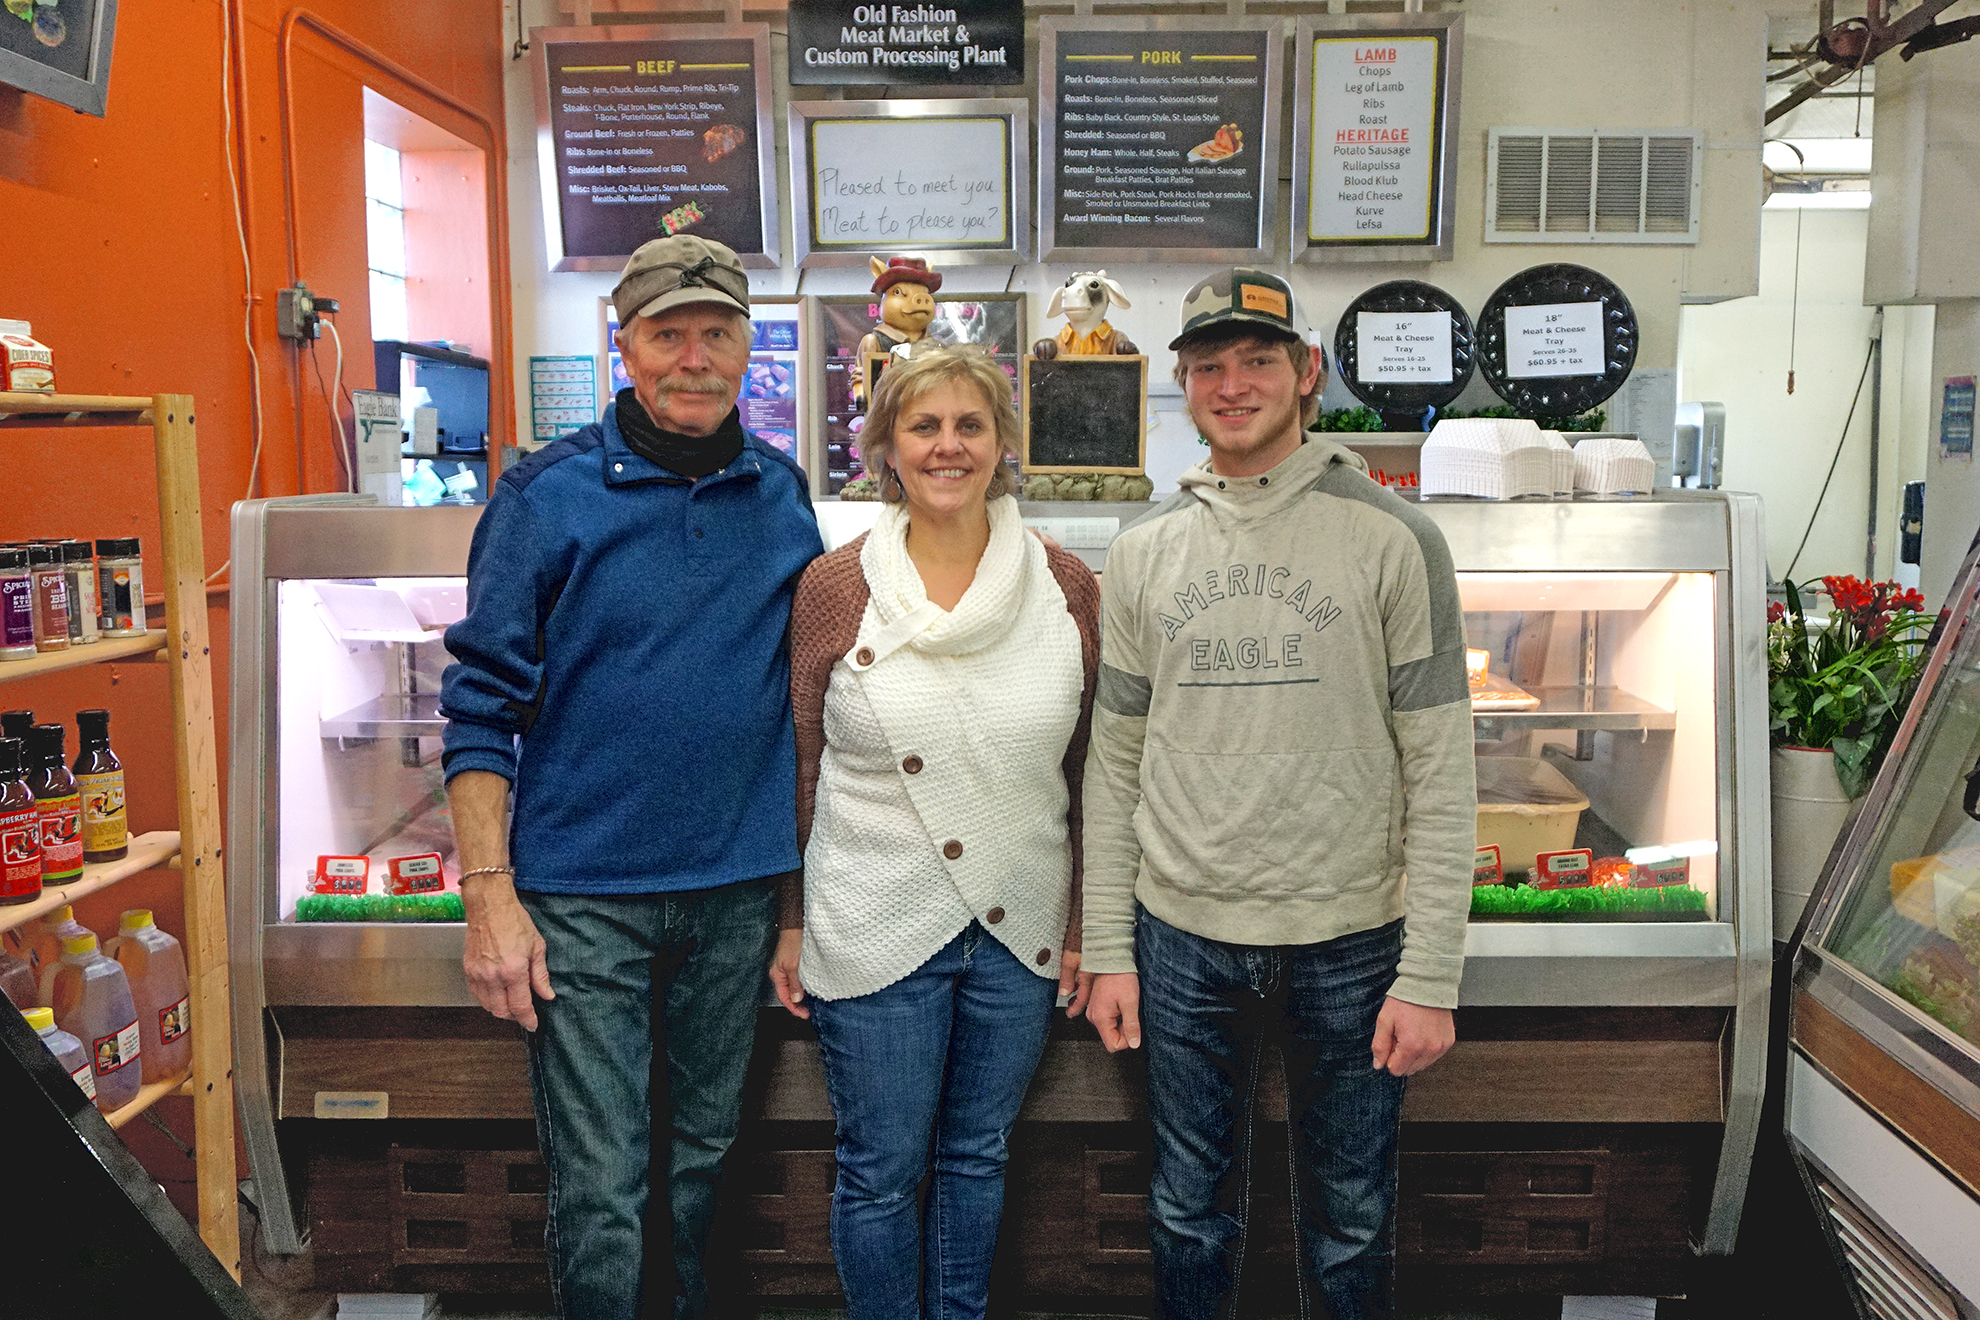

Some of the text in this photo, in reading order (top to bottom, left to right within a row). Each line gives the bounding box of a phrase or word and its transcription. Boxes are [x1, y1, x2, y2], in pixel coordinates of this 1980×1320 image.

[853, 4, 956, 23] Old Fashion
[841, 25, 969, 43] Meat Market &
[805, 45, 1006, 70] Custom Processing Plant
[1142, 51, 1181, 64] PORK
[1355, 49, 1397, 61] LAMB
[637, 60, 675, 73] BEEF
[1359, 66, 1391, 77] Chops
[1065, 76, 1083, 84] Pork
[1085, 76, 1111, 85] Chops:
[1140, 76, 1170, 84] Boneless,
[1172, 76, 1199, 84] Smoked,
[1226, 76, 1257, 84] Seasoned
[719, 84, 739, 93] Tri-Tip
[1345, 82, 1404, 94] Leg of Lamb
[1065, 95, 1092, 103] Roasts:
[1125, 95, 1156, 103] Boneless,
[1363, 99, 1385, 108] Ribs
[648, 103, 662, 111] New
[1086, 114, 1103, 122] Baby
[1124, 113, 1150, 122] Country
[1152, 114, 1170, 122] Style,
[1203, 114, 1219, 122] Style
[1359, 115, 1387, 125] Roast
[565, 130, 593, 139] Ground
[1065, 131, 1104, 139] Shredded:
[1150, 132, 1165, 140] BBQ
[1337, 129, 1409, 141] HERITAGE
[1064, 149, 1088, 157] Honey
[1114, 149, 1138, 157] Whole,
[1334, 146, 1411, 156] Potato Sausage
[568, 166, 605, 174] Shredded
[628, 165, 661, 173] Seasoned
[671, 165, 687, 173] BBQ
[1064, 166, 1095, 174] Ground:
[1150, 167, 1179, 175] Sausage,
[1217, 167, 1246, 175] Sausage
[1343, 161, 1400, 172] Rullapulssa
[819, 167, 885, 196] Pleased
[895, 170, 916, 195] to
[923, 175, 957, 194] meet
[1096, 176, 1127, 184] Breakfast
[1129, 176, 1153, 184] Patties,
[1345, 176, 1398, 185] Blood Klub
[1064, 190, 1084, 198] Misc:
[1137, 191, 1157, 199] Steak,
[1339, 191, 1403, 201] Head Cheese
[1356, 206, 1384, 215] Kurve
[823, 206, 998, 240] Meat to please you?
[1064, 214, 1088, 222] Award
[1090, 214, 1122, 223] Winning
[1125, 214, 1150, 222] Bacon:
[1357, 220, 1382, 229] Lefsa
[1555, 325, 1586, 333] Cheese
[1405, 334, 1434, 342] Cheese
[1545, 337, 1564, 345] Tray
[1528, 358, 1559, 367] $60.95
[1158, 564, 1342, 642] AMERICAN
[1191, 634, 1302, 671] EAGLE
